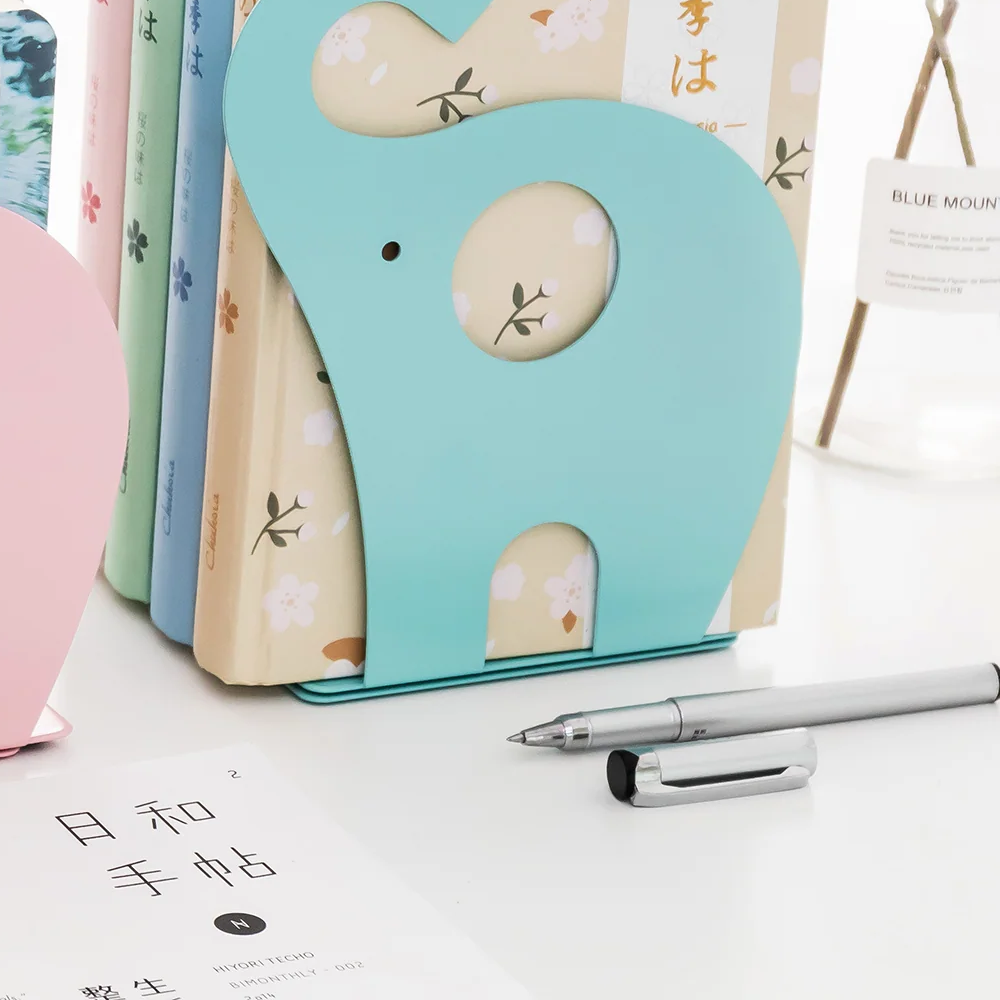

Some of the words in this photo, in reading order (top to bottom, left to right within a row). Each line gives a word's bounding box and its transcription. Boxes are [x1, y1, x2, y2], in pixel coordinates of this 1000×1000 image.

[892, 189, 937, 208] BLUE
[943, 195, 1000, 210] MOUN
[227, 769, 242, 779] 2
[55, 800, 216, 847] 日和
[106, 846, 277, 897] 手帖
[212, 959, 265, 974] HIYORI
[265, 951, 316, 966] TECHO
[228, 968, 318, 989] BIMONTHLY
[334, 961, 366, 972] 002
